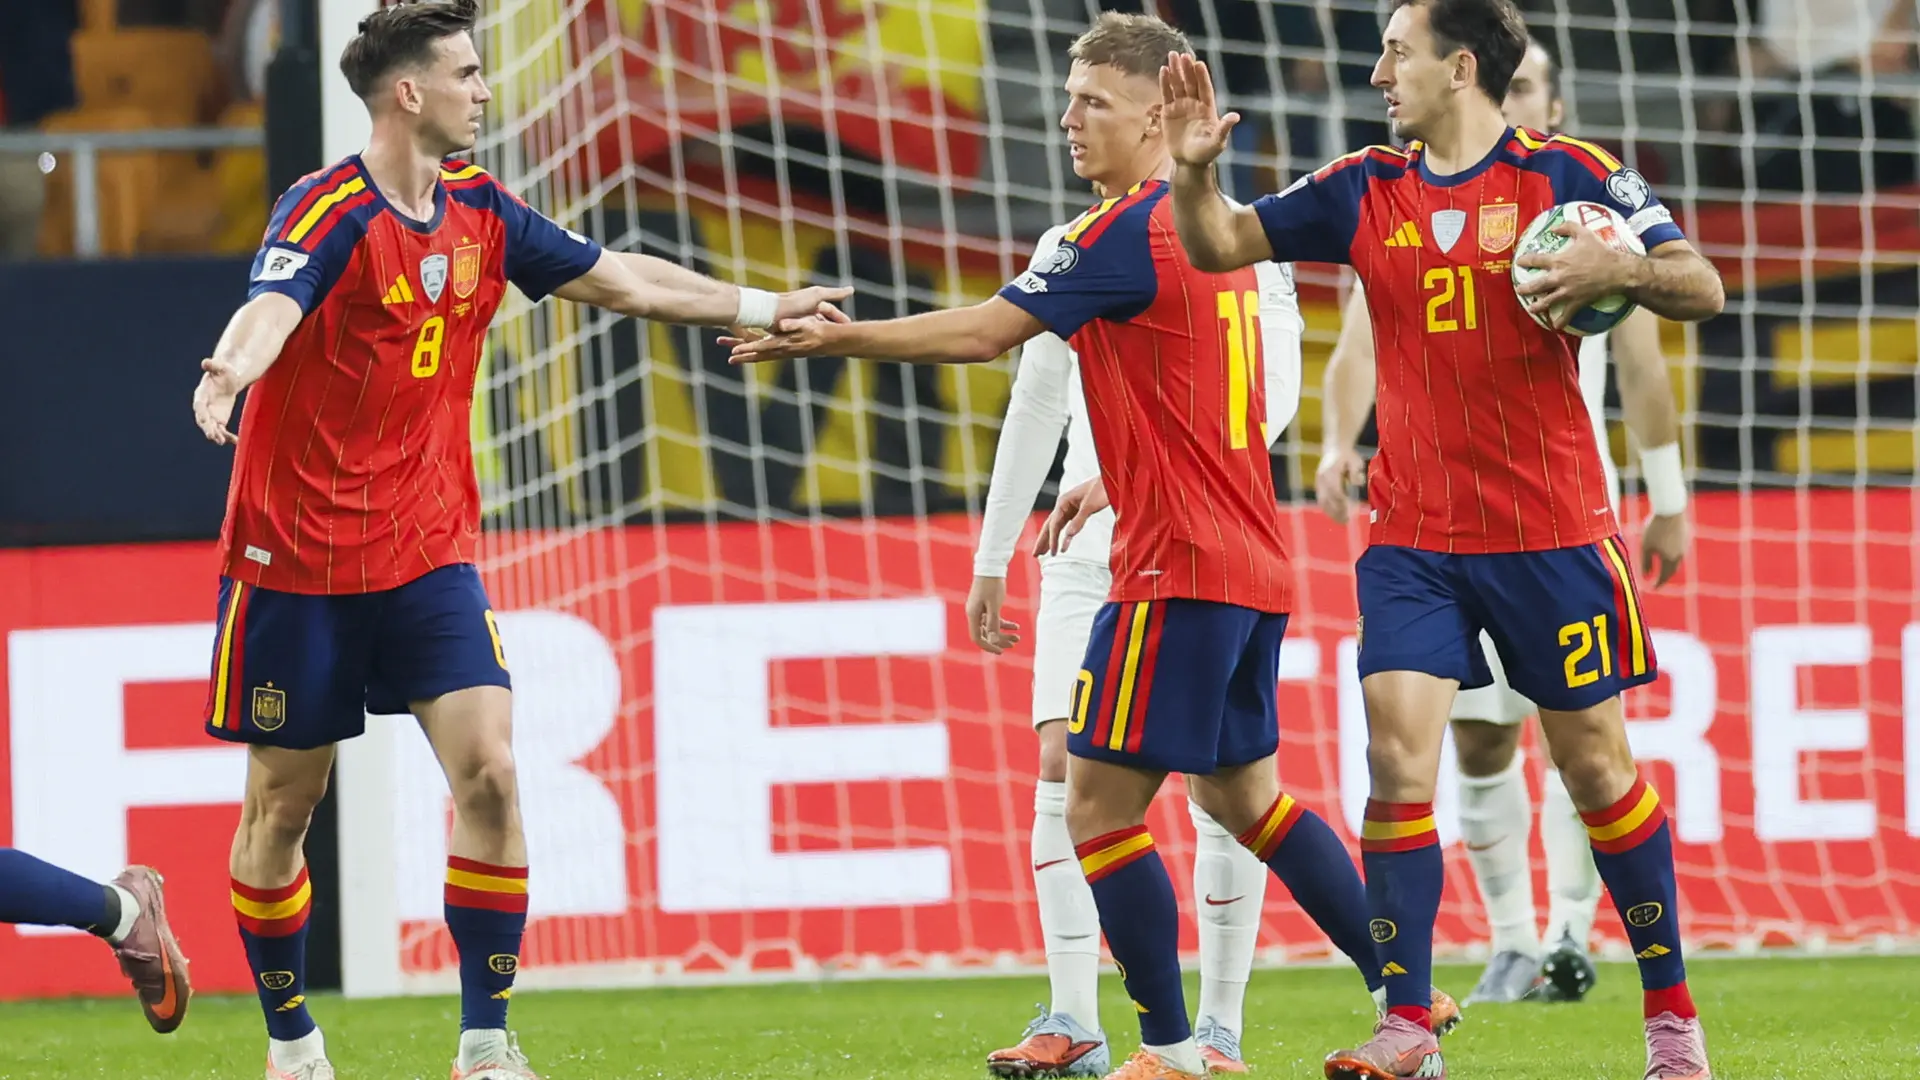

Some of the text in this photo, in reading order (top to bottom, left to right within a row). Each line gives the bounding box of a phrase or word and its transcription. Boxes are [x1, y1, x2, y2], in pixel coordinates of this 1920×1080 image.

[1424, 265, 1477, 333] 21
[411, 316, 445, 379] 8
[1558, 613, 1612, 689] 21
[8, 597, 952, 935] FRE
